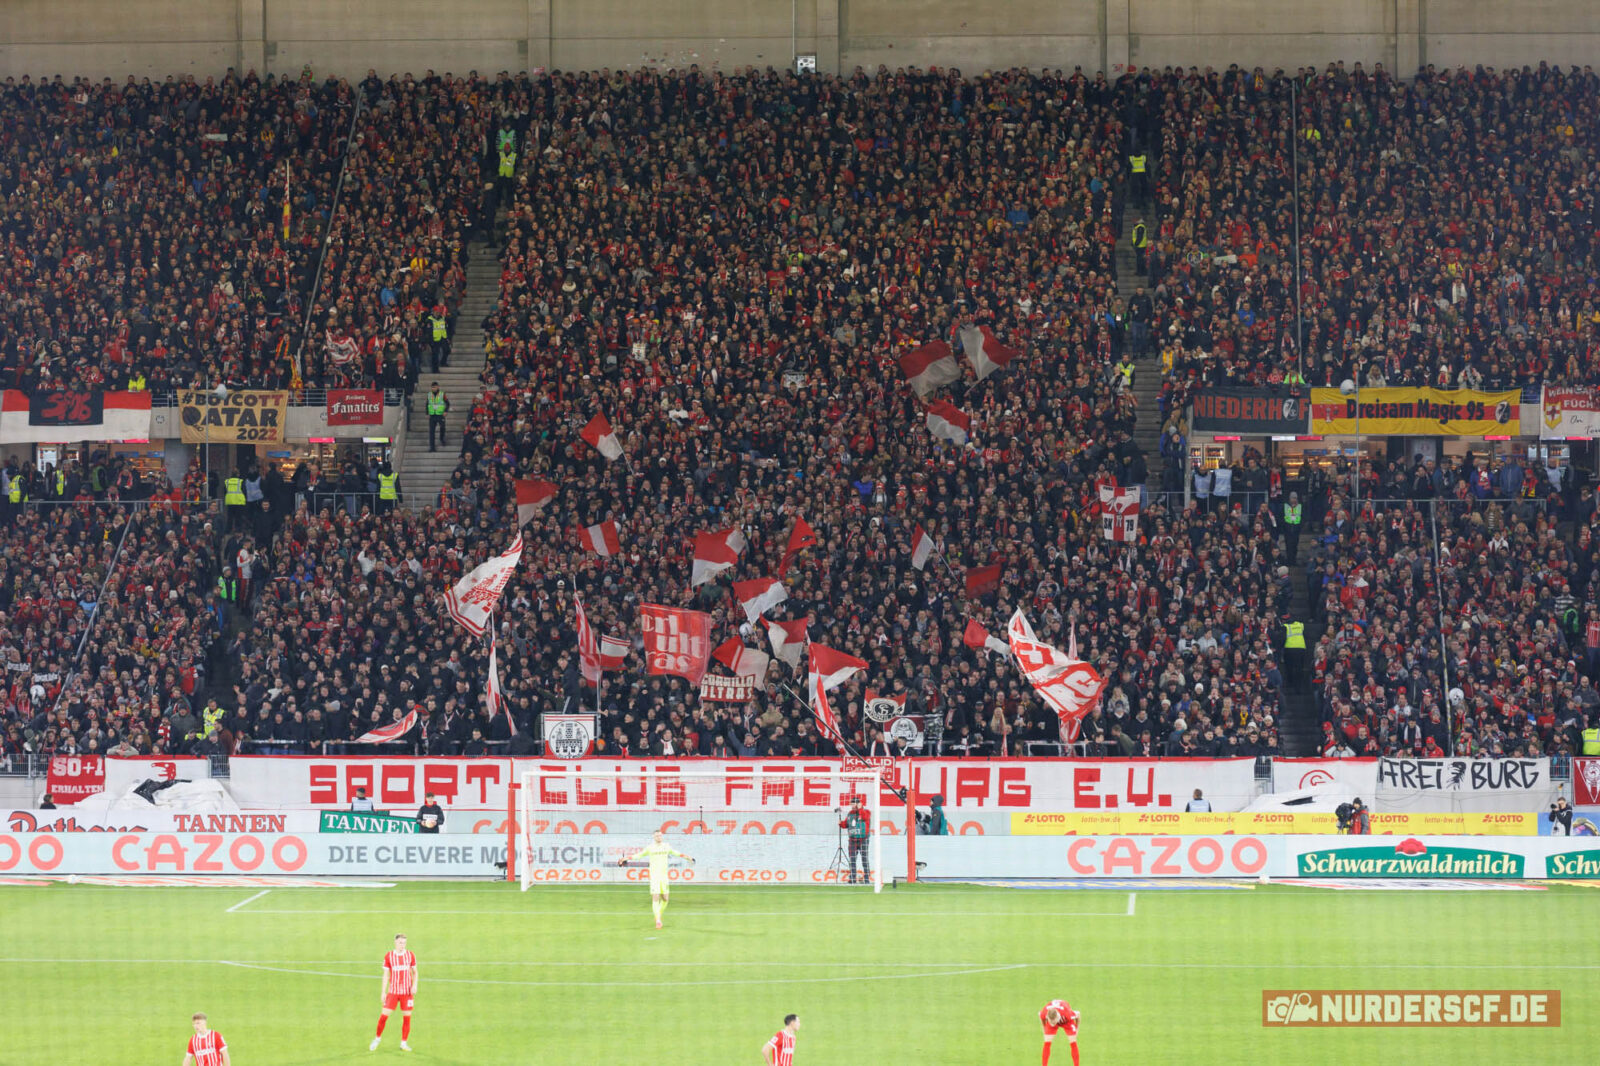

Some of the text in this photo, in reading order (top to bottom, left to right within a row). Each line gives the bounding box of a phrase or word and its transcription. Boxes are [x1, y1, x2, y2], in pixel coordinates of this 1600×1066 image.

[330, 402, 381, 416] Fanatics
[1346, 398, 1485, 425] Dreisam Magic 95
[182, 406, 278, 428] QATAR
[236, 427, 278, 441] 2022
[700, 684, 752, 699] ULTRAS
[846, 758, 892, 766] KHALID
[1471, 760, 1540, 789] BURG
[51, 784, 104, 793] ERHALTEN
[173, 814, 287, 832] TANNEN
[324, 813, 417, 833] TANNEN
[1036, 815, 1065, 823] LOTTO
[1150, 814, 1180, 822] LOTTO
[1265, 814, 1295, 822] LOTTO
[1379, 815, 1409, 823] LOTTO
[1494, 815, 1524, 823] LOTTO
[112, 834, 308, 872] CAZOO
[328, 846, 368, 863] DIE
[374, 846, 473, 864] CLEVERE
[1067, 837, 1268, 875] CAZOO
[1303, 853, 1518, 874] Schwarzwaldmilch
[533, 868, 602, 881] CAZOO
[626, 868, 695, 881] CAOO
[719, 869, 788, 881] CAZOO
